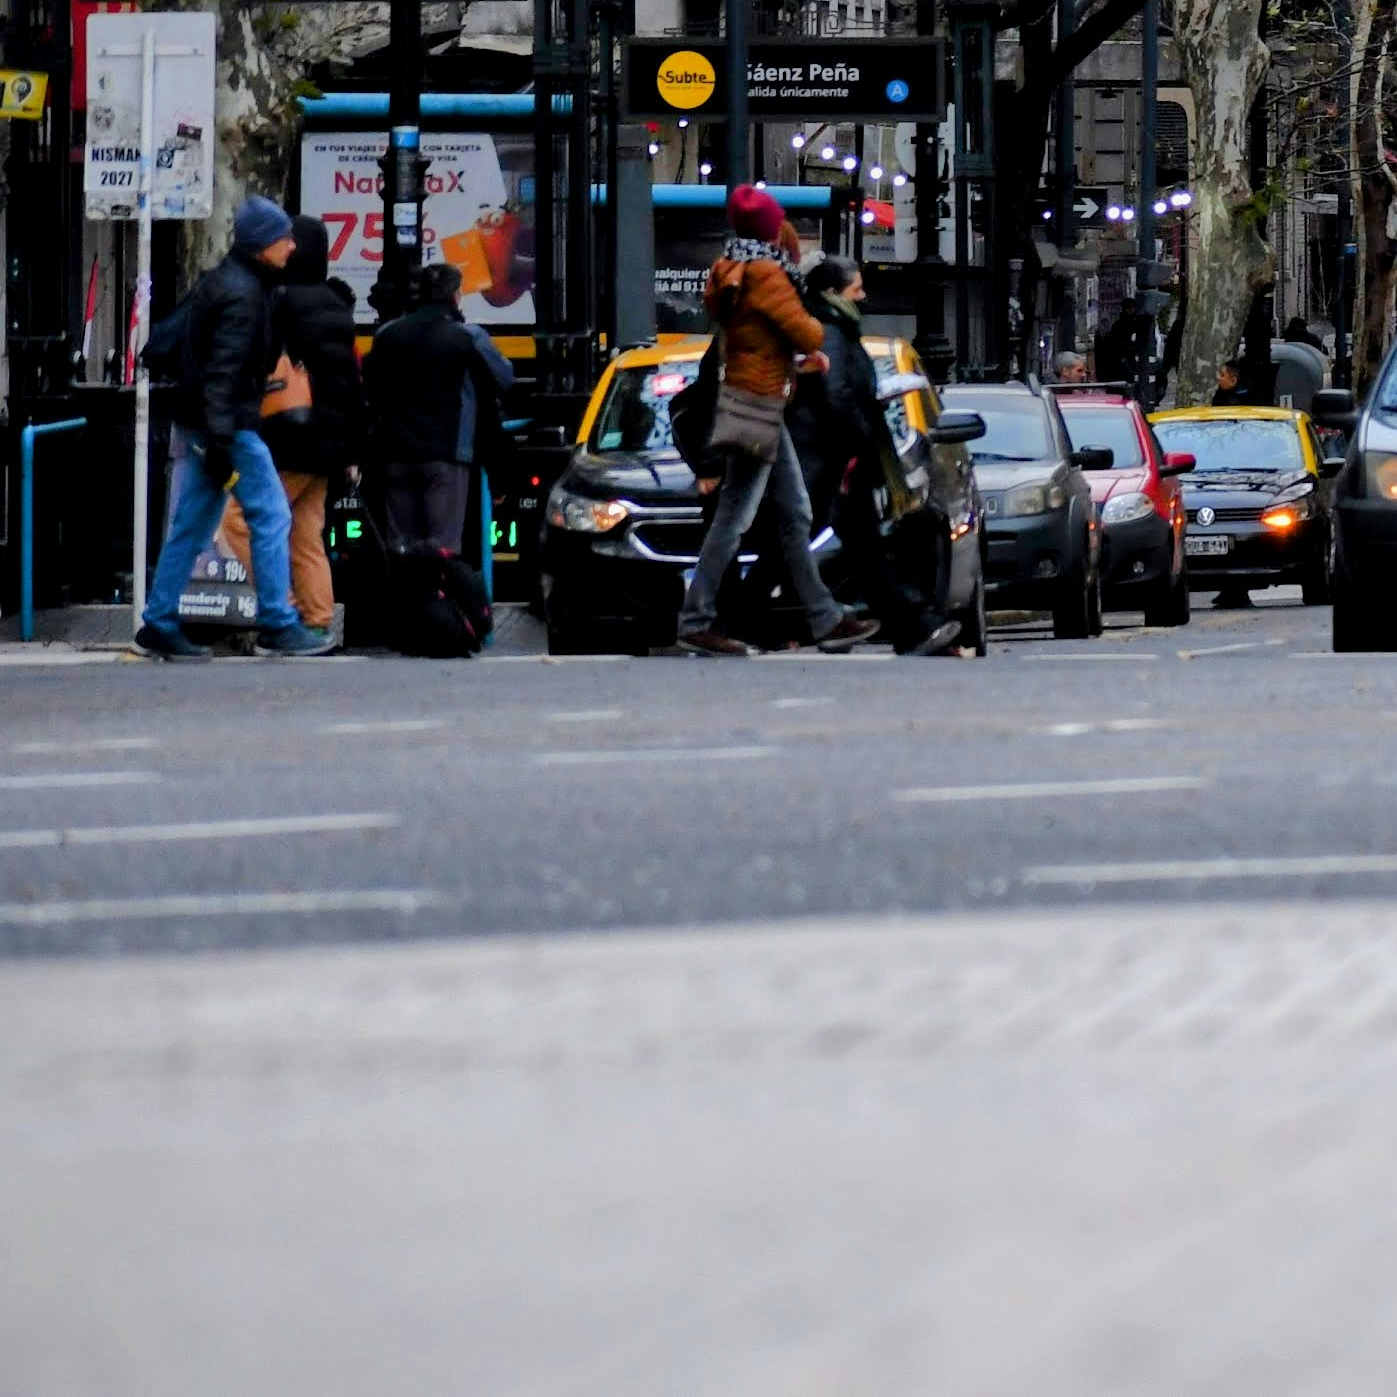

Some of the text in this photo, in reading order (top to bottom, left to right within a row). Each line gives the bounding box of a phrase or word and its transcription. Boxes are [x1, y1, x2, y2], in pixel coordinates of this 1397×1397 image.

[665, 70, 708, 84] Subte
[809, 63, 860, 82] Peña
[748, 86, 849, 98] alida únicamente
[101, 170, 133, 186] 2027
[683, 281, 706, 292] 911
